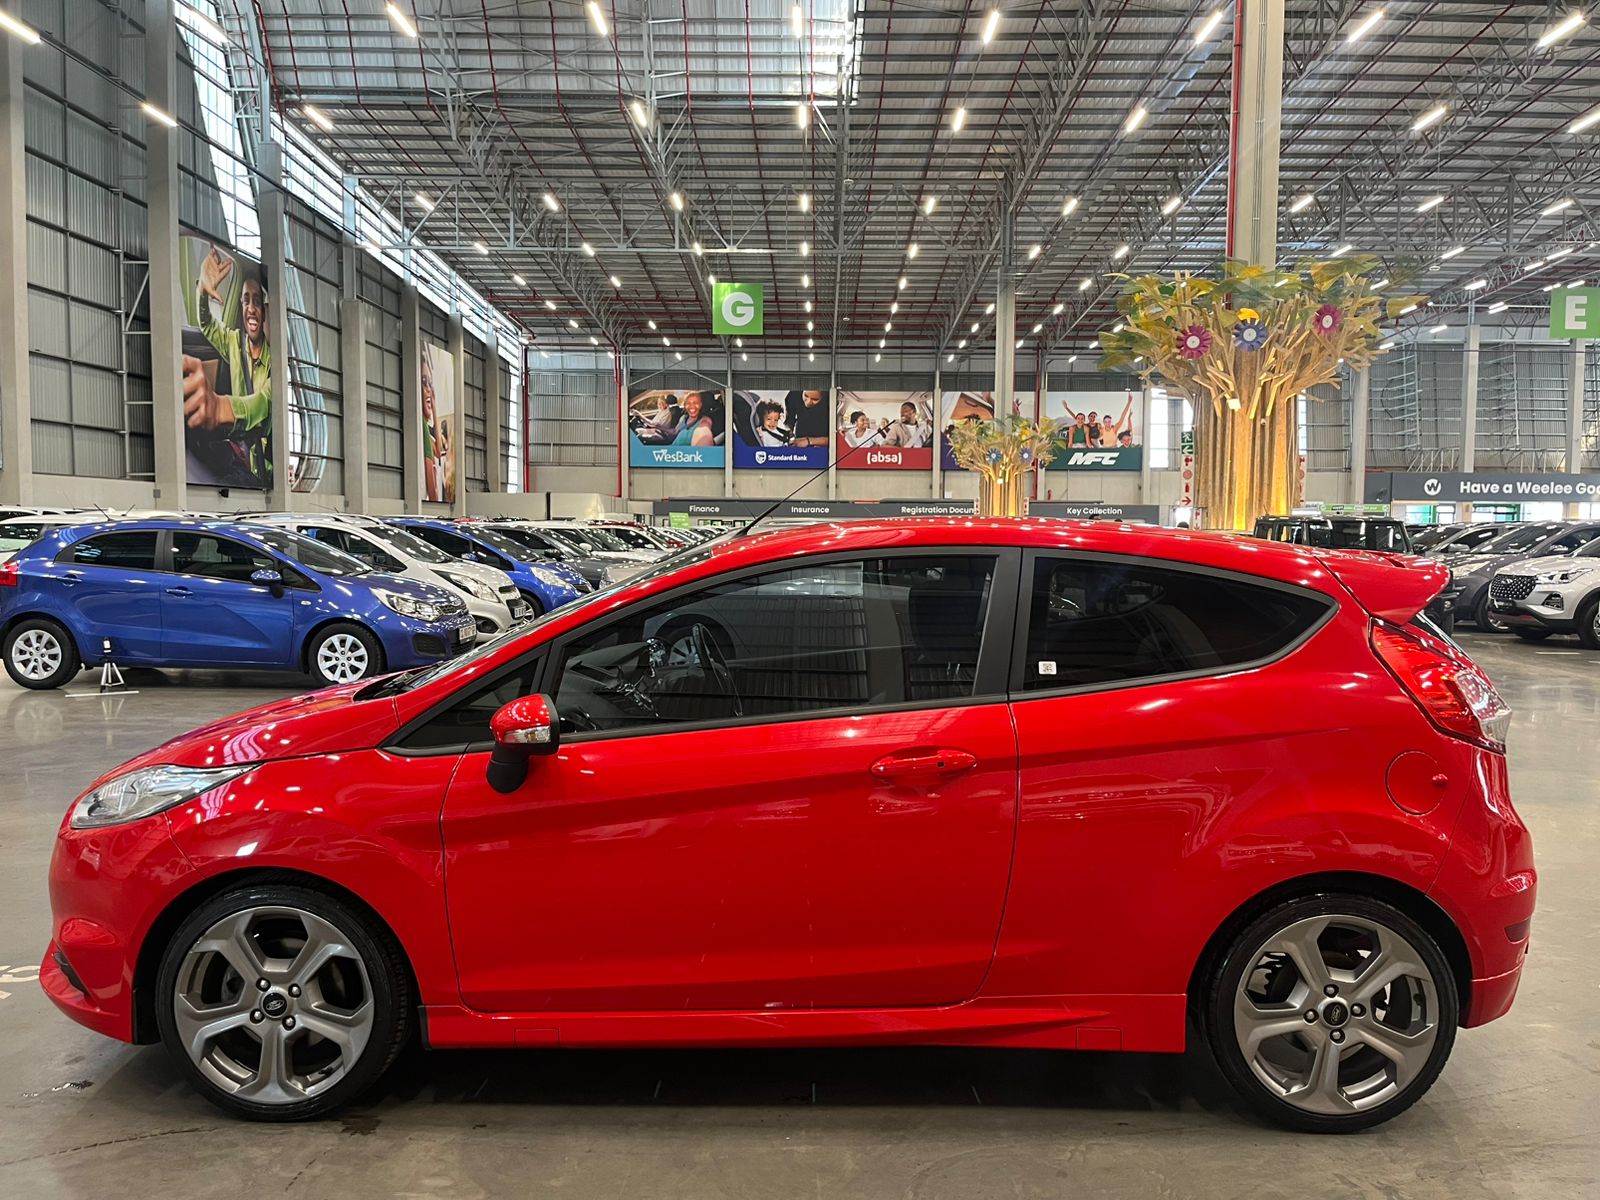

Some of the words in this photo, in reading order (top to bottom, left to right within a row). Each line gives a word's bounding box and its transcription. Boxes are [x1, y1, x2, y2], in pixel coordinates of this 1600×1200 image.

[722, 291, 754, 327] G
[1565, 296, 1587, 329] E
[653, 449, 702, 463] WesBank
[768, 454, 792, 462] Standard
[793, 454, 807, 462] Bank
[1068, 452, 1119, 465] MFC
[1460, 481, 1499, 494] Have
[1503, 482, 1513, 494] a
[1517, 481, 1573, 495] Weelee
[689, 505, 720, 513] Finance
[791, 506, 829, 514] Insurance
[901, 506, 948, 515] Registration
[1066, 507, 1081, 516] Key
[1082, 507, 1122, 515] Collection
